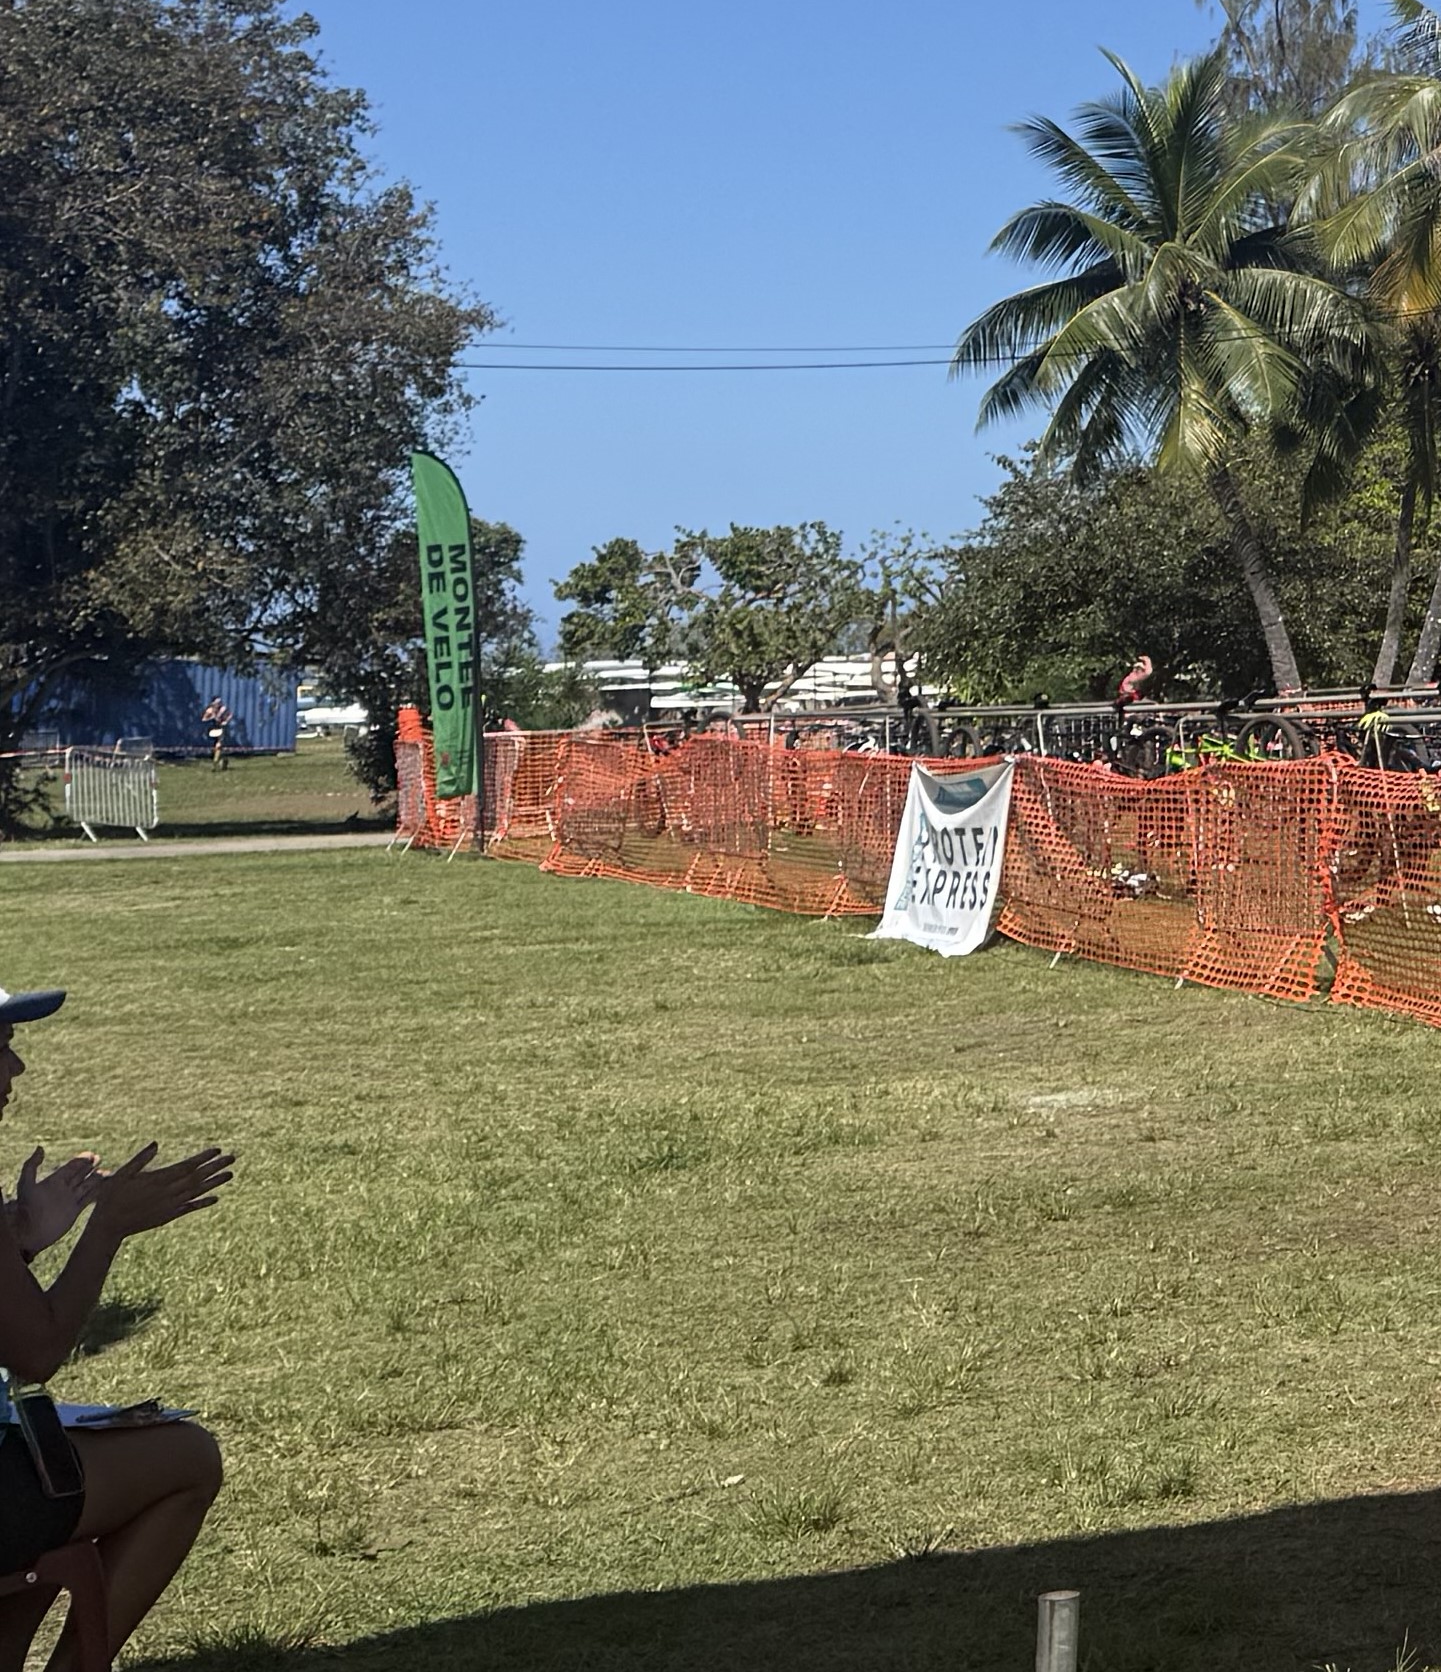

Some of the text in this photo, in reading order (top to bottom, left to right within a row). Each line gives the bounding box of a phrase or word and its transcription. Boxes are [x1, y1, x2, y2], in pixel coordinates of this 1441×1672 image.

[426, 543, 455, 712] DE VELO
[448, 544, 473, 710] MONTEE
